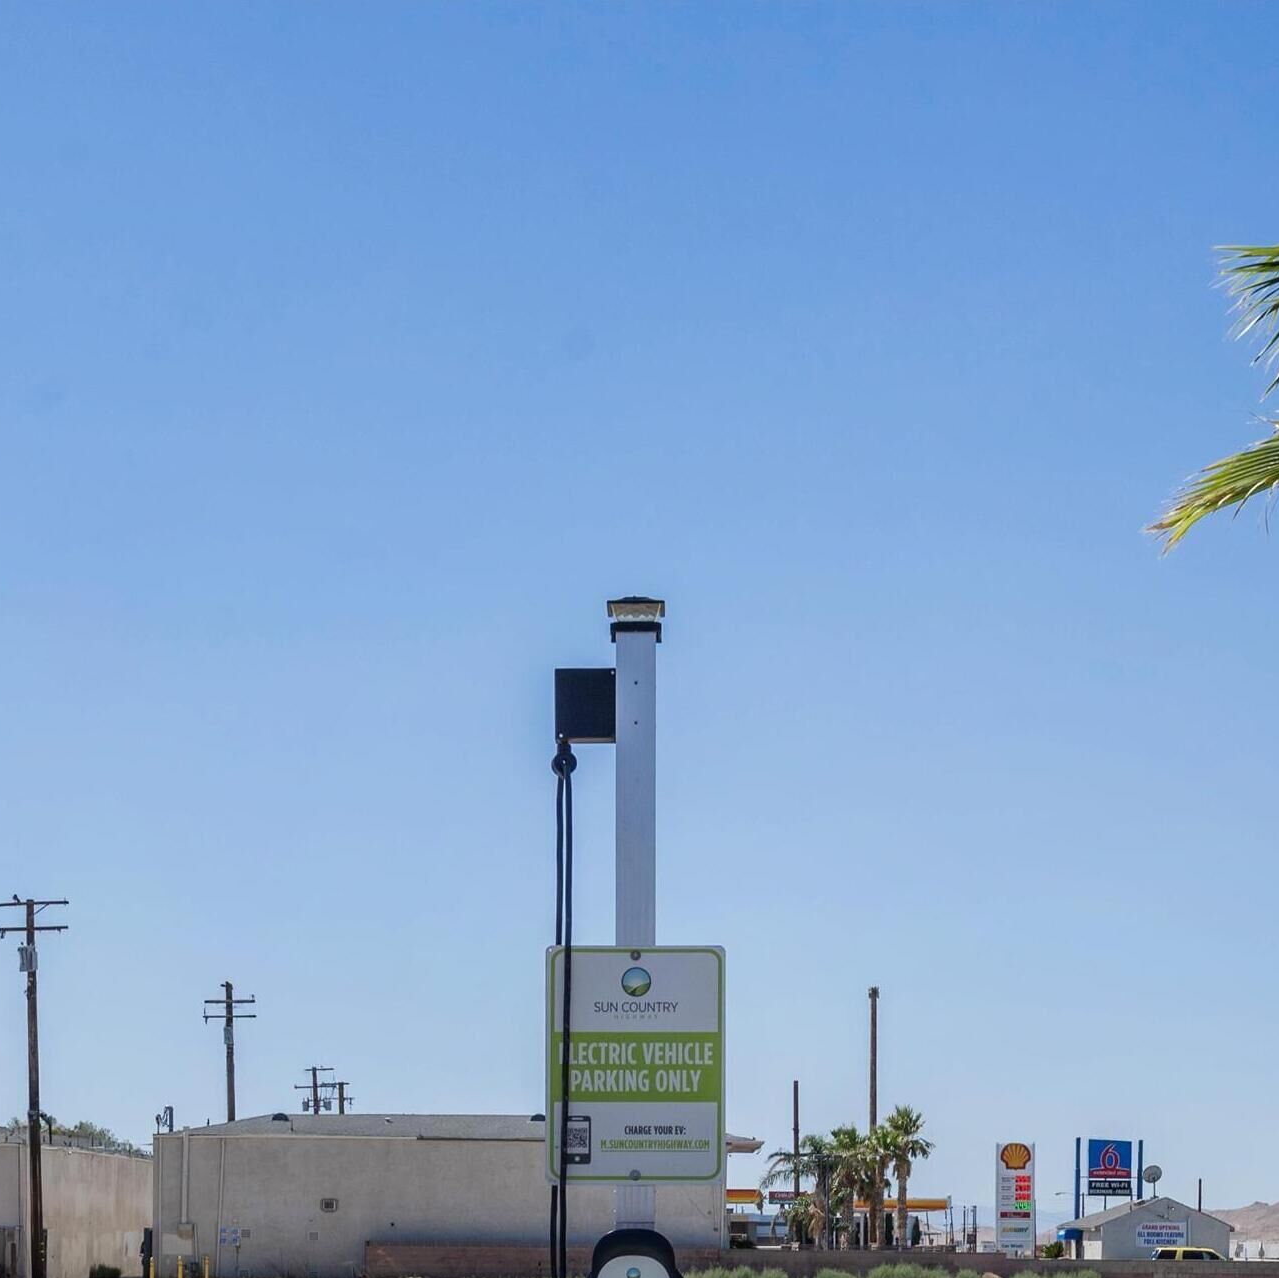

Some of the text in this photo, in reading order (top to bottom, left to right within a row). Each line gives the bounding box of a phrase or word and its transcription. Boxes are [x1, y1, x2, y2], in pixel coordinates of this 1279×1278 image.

[594, 1002, 678, 1013] SUN COUNTRY
[642, 1043, 713, 1065] VEHICLE
[571, 1070, 701, 1093] PARKING ONLY
[624, 1126, 686, 1135] CHARGE YOUR EV:
[600, 1139, 710, 1150] M.SUNCOUNTRYHIGHWAY.COM
[1100, 1143, 1119, 1168] 6
